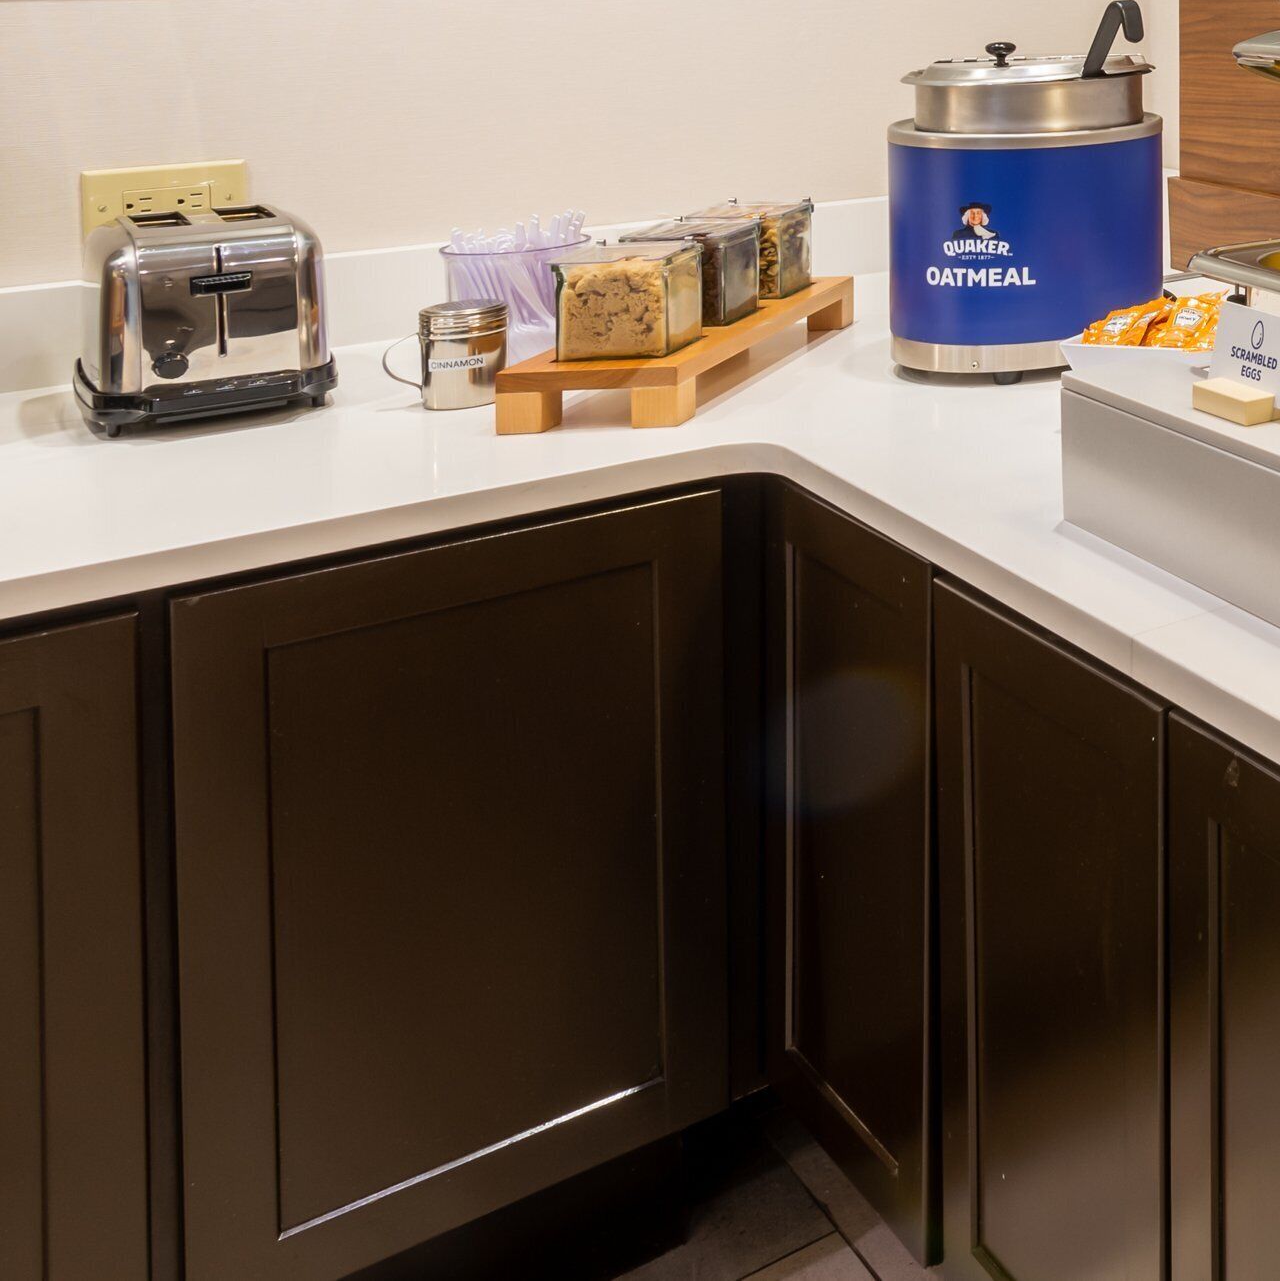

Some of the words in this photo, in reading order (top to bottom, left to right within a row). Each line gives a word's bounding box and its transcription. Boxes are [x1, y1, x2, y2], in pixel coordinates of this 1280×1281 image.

[943, 239, 1010, 256] QUAKER
[926, 266, 1037, 287] OATMEAL
[431, 358, 484, 369] CINNAMON
[1231, 346, 1278, 370] SCRAMBLED
[1241, 364, 1261, 382] EGGS
